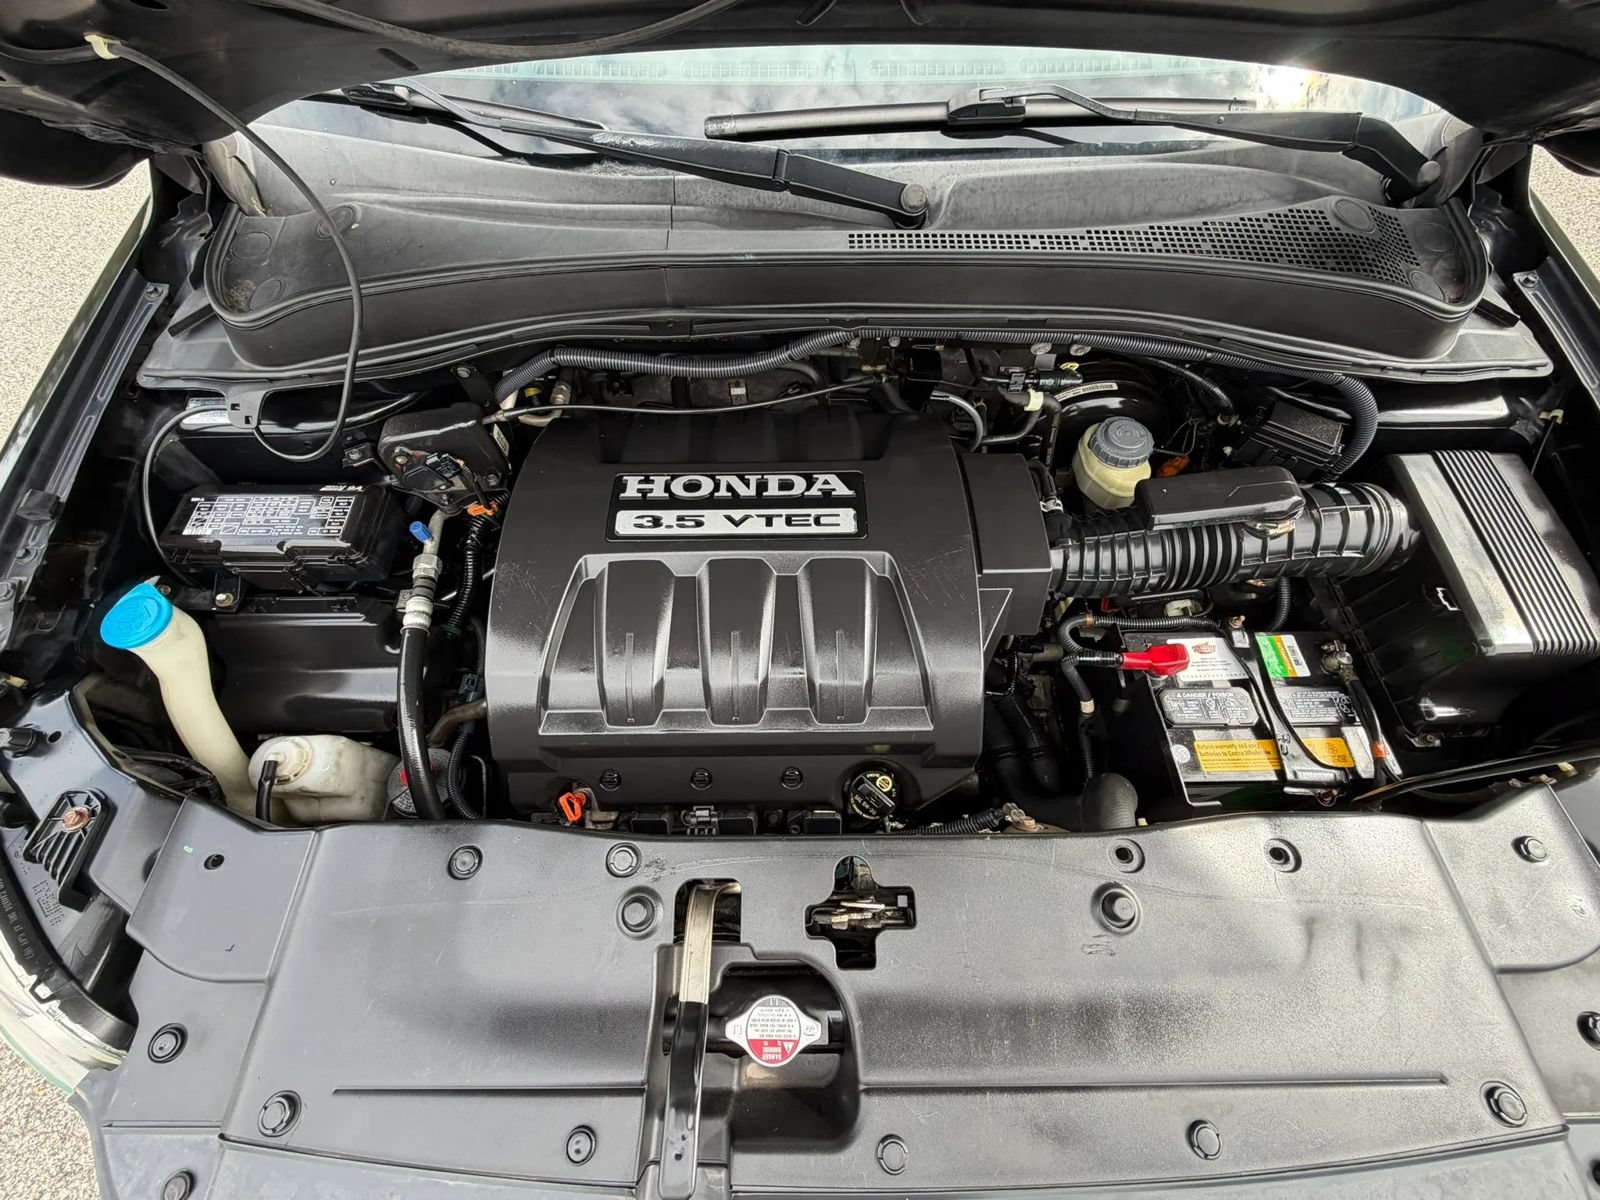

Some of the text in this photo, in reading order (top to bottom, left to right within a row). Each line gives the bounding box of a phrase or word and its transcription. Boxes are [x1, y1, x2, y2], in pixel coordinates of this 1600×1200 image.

[618, 473, 857, 500] HONDA
[633, 513, 841, 529] 3.5 VTEC
